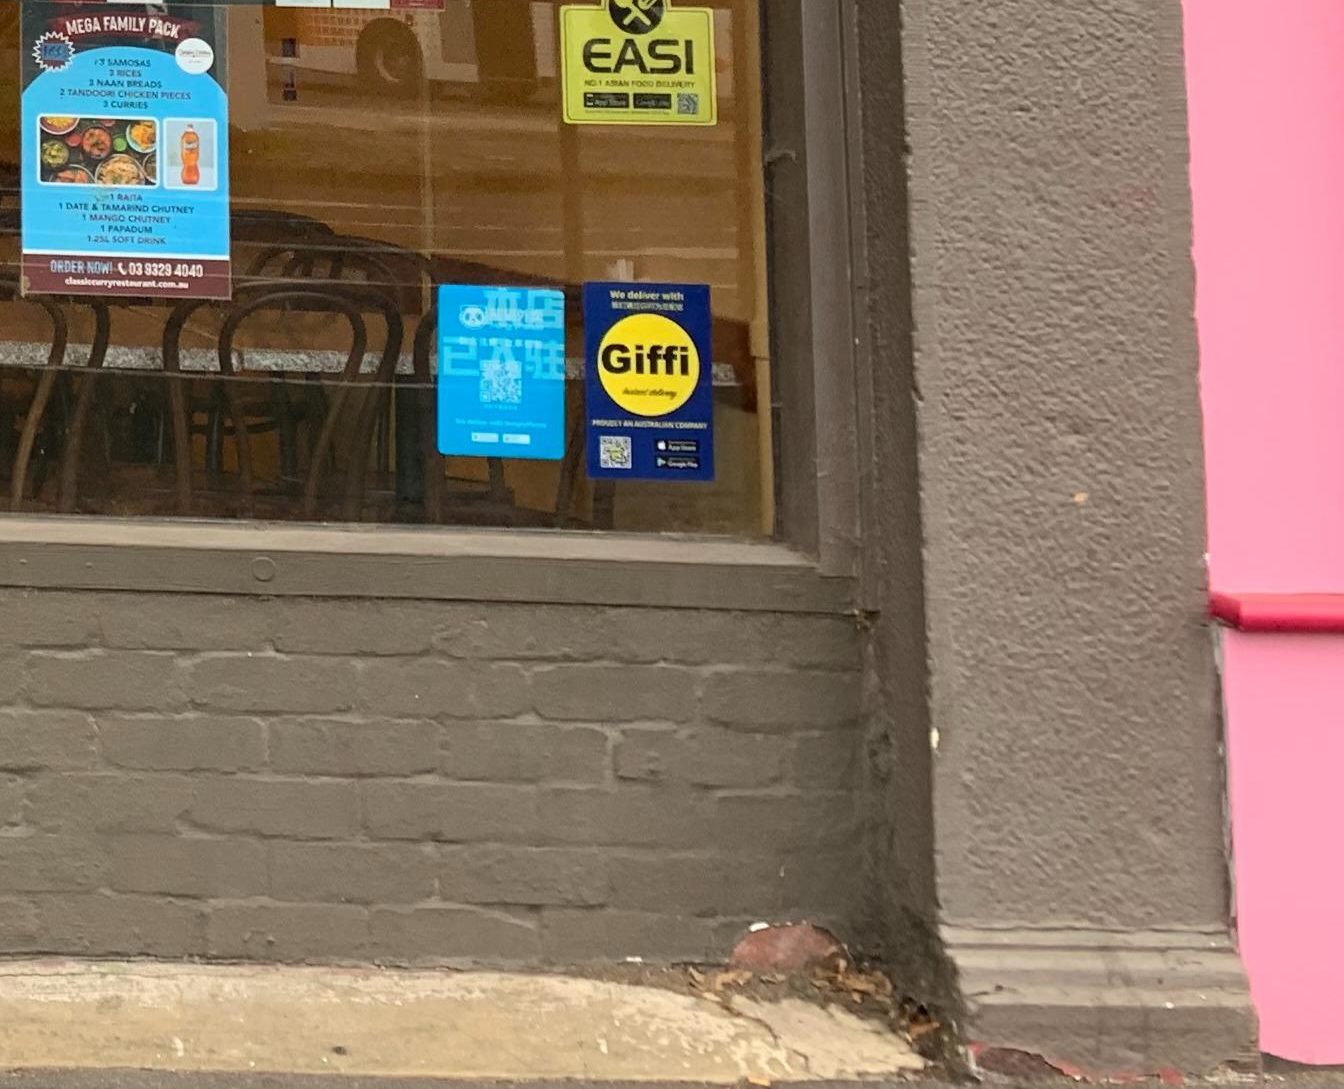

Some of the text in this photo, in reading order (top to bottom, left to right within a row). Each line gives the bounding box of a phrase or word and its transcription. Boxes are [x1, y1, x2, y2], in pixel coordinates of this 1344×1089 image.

[65, 16, 181, 39] MEGA FAMILY PACK
[582, 38, 694, 74] EASI
[107, 59, 151, 67] SAMOSAS
[96, 79, 162, 88] NAAN BREADS
[67, 89, 116, 98] TANDOORI
[118, 91, 158, 99] CHICKEN
[161, 92, 191, 100] PIECES
[110, 101, 148, 109] CURRIES
[117, 193, 143, 201] RAITA
[101, 204, 149, 212] TAMARIND
[151, 205, 194, 214] CHUTNEY
[89, 214, 125, 222] MANGO
[128, 215, 171, 223] CHUTNEY
[108, 225, 153, 233] PAPADUM
[137, 236, 166, 245] DRINK
[50, 260, 85, 274] ORDER
[128, 262, 143, 276] 03
[145, 263, 171, 276] 9329
[173, 263, 203, 277] 4040
[64, 276, 189, 289] classiccurryrestaurant.com.au
[610, 290, 684, 301] We deliver with
[601, 343, 689, 376] Giffi
